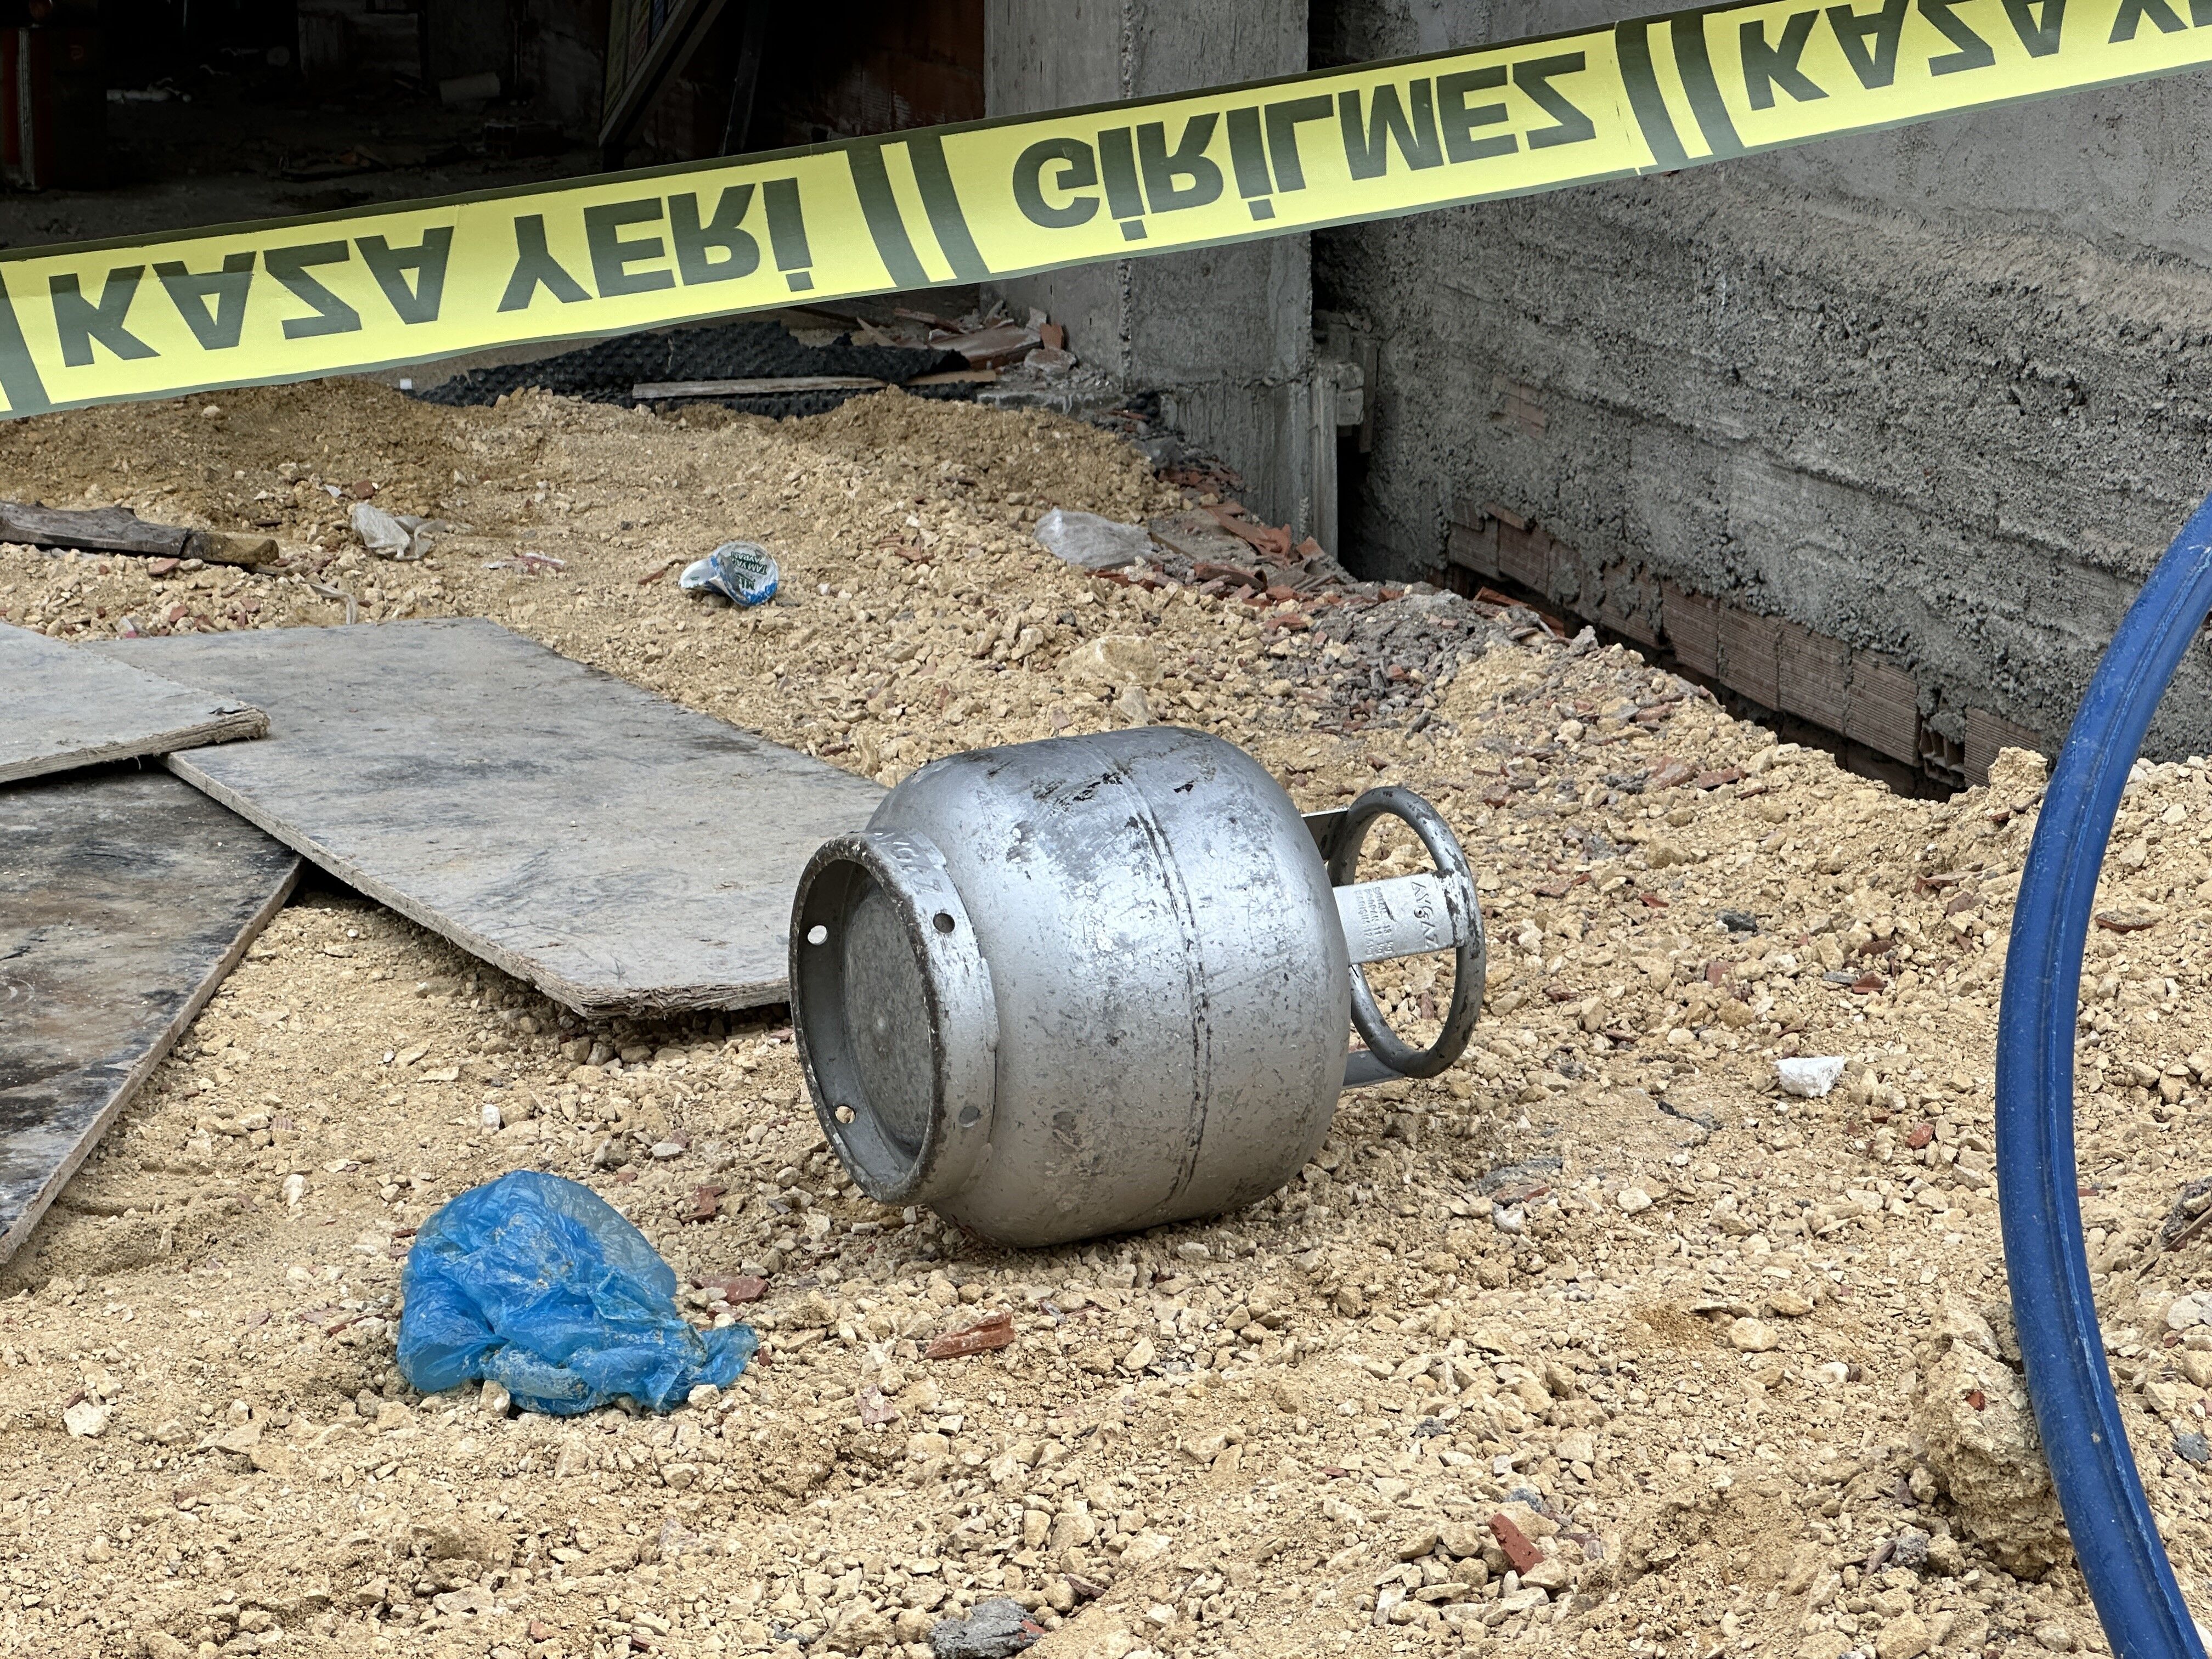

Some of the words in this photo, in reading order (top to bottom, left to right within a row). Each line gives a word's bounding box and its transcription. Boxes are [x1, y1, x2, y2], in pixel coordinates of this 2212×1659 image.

[731, 551, 761, 563] AYRAN
[748, 562, 768, 575] TAM
[1412, 881, 1438, 949] AYGAZ
